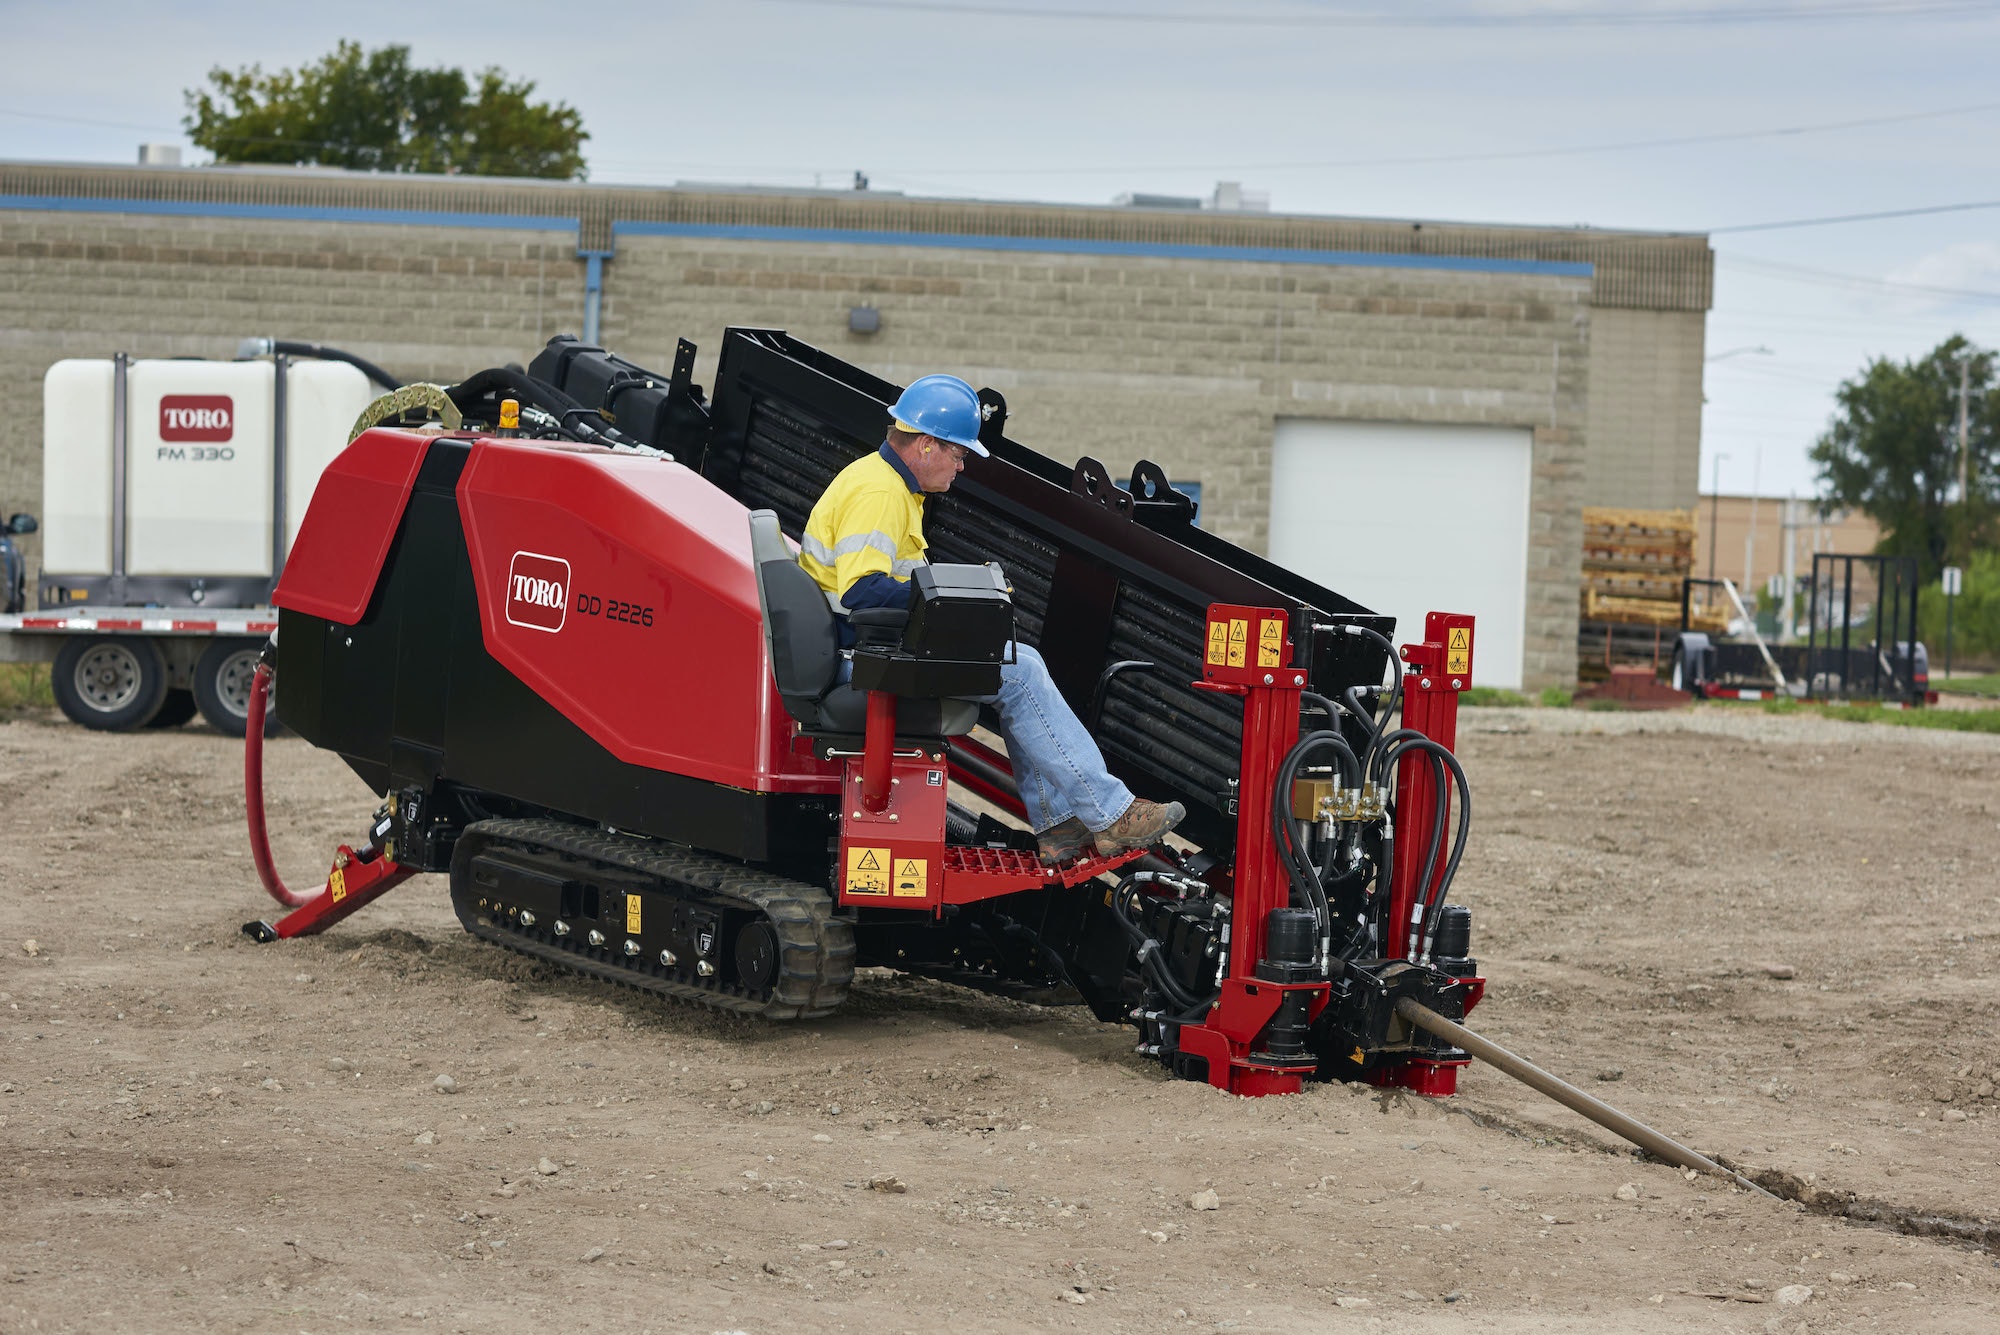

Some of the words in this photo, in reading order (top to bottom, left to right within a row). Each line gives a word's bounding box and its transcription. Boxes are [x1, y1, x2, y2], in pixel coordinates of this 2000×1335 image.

[164, 407, 229, 429] TORO
[157, 447, 186, 460] FM
[191, 447, 235, 461] 330
[513, 574, 564, 610] TORO
[577, 593, 602, 616] DD
[606, 599, 654, 627] 2226
